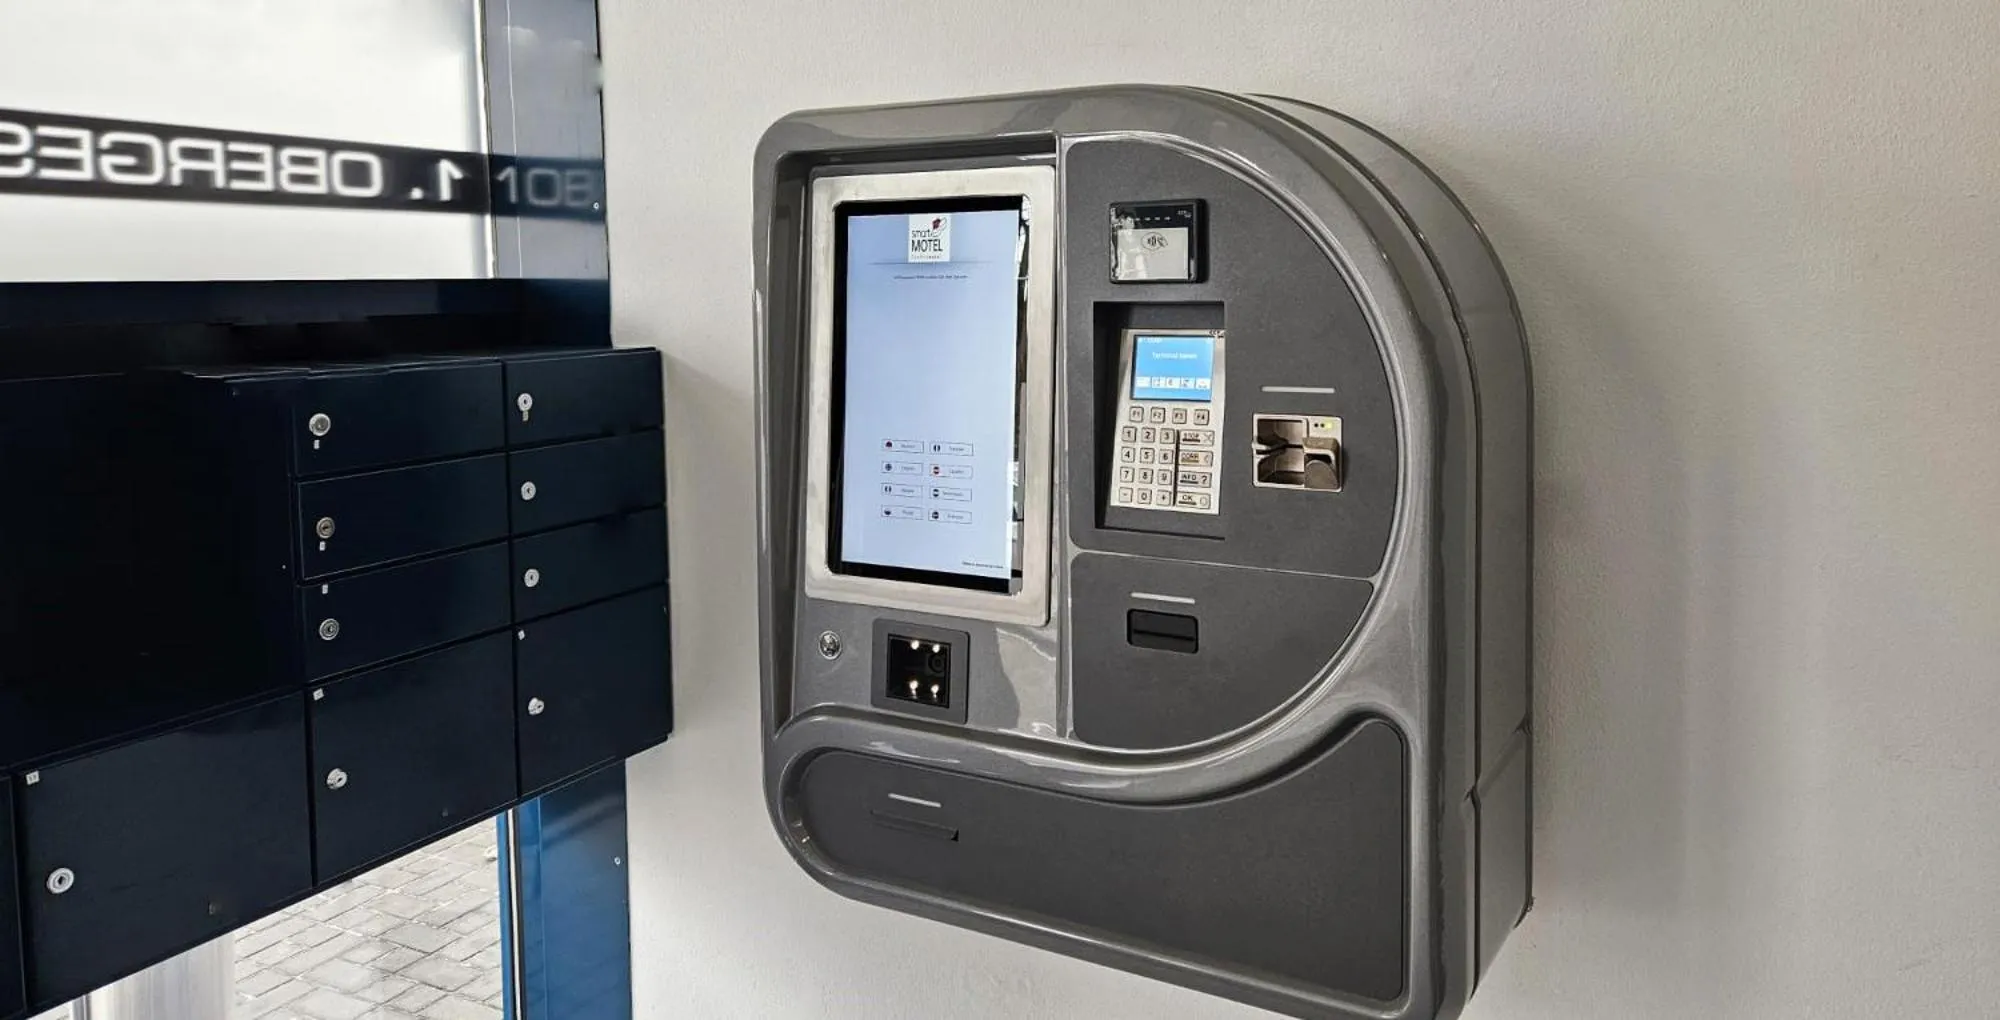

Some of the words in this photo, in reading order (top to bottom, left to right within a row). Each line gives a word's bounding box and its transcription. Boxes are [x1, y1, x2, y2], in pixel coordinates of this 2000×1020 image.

[911, 239, 943, 253] MOTEL
[1127, 430, 1131, 438] 1
[1146, 431, 1151, 440] 2
[1165, 432, 1170, 440] 3
[1125, 450, 1130, 458] 4
[1144, 451, 1149, 459] 5
[1124, 470, 1128, 480] 7
[1142, 472, 1147, 480] 8
